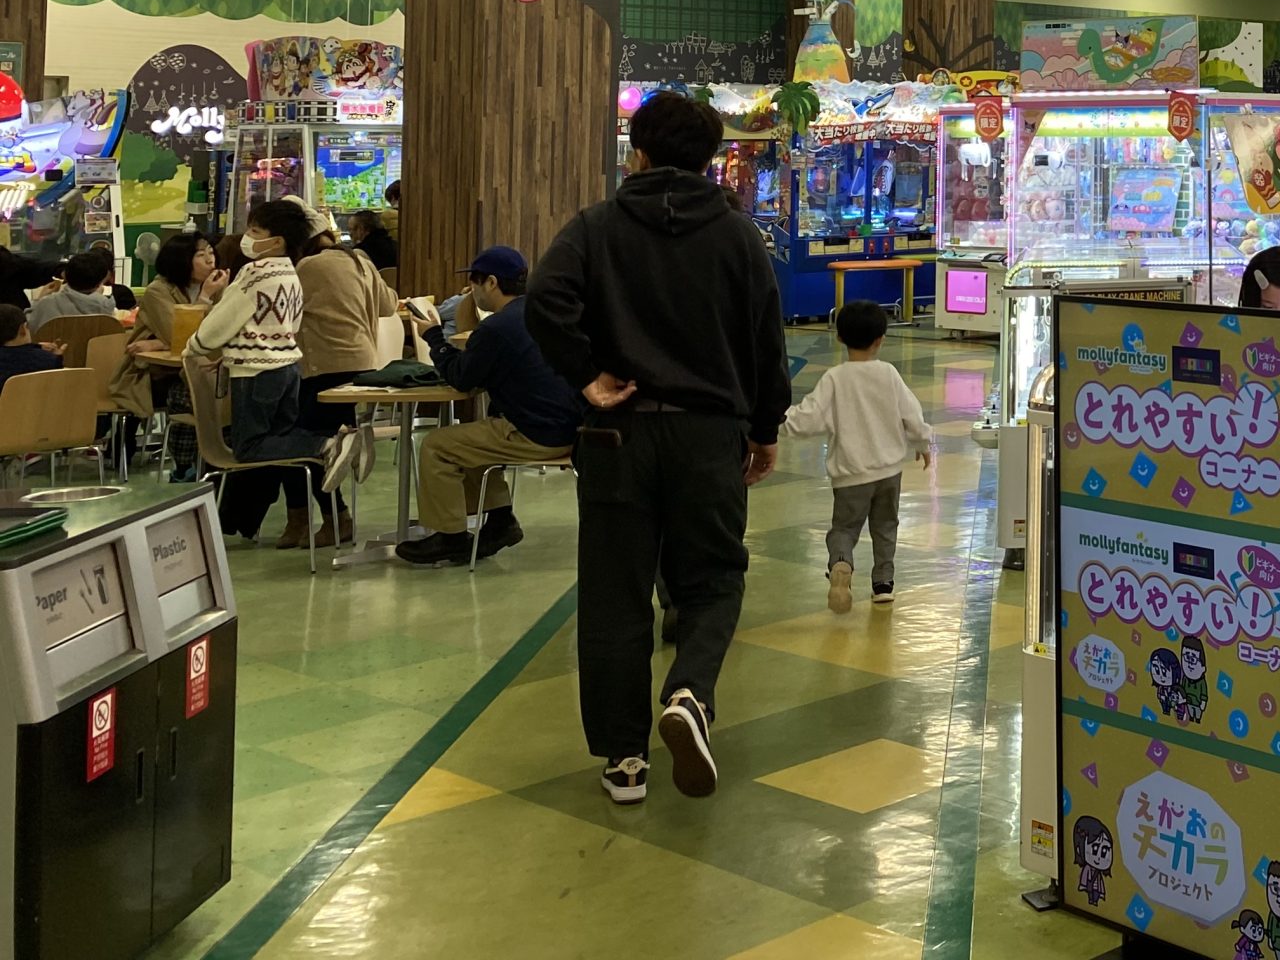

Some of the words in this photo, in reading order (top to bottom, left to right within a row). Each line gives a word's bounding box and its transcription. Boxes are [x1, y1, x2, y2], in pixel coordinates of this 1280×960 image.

[1119, 292, 1145, 301] CRANE
[1146, 290, 1181, 301] MACHINE
[1078, 346, 1167, 372] mollyfantasy
[1262, 361, 1276, 373] 向け
[1205, 460, 1278, 482] コーナー
[152, 536, 187, 563] Plastic
[1079, 533, 1169, 565] mollyfantasy
[1259, 570, 1275, 583] 向け
[1083, 642, 1119, 660] えがおの
[1083, 655, 1120, 678] チカラ
[1088, 672, 1114, 685] プロジェクト
[1134, 791, 1226, 841] えがおの
[1133, 823, 1229, 886] チカラ
[1147, 865, 1214, 902] プロジェクト
